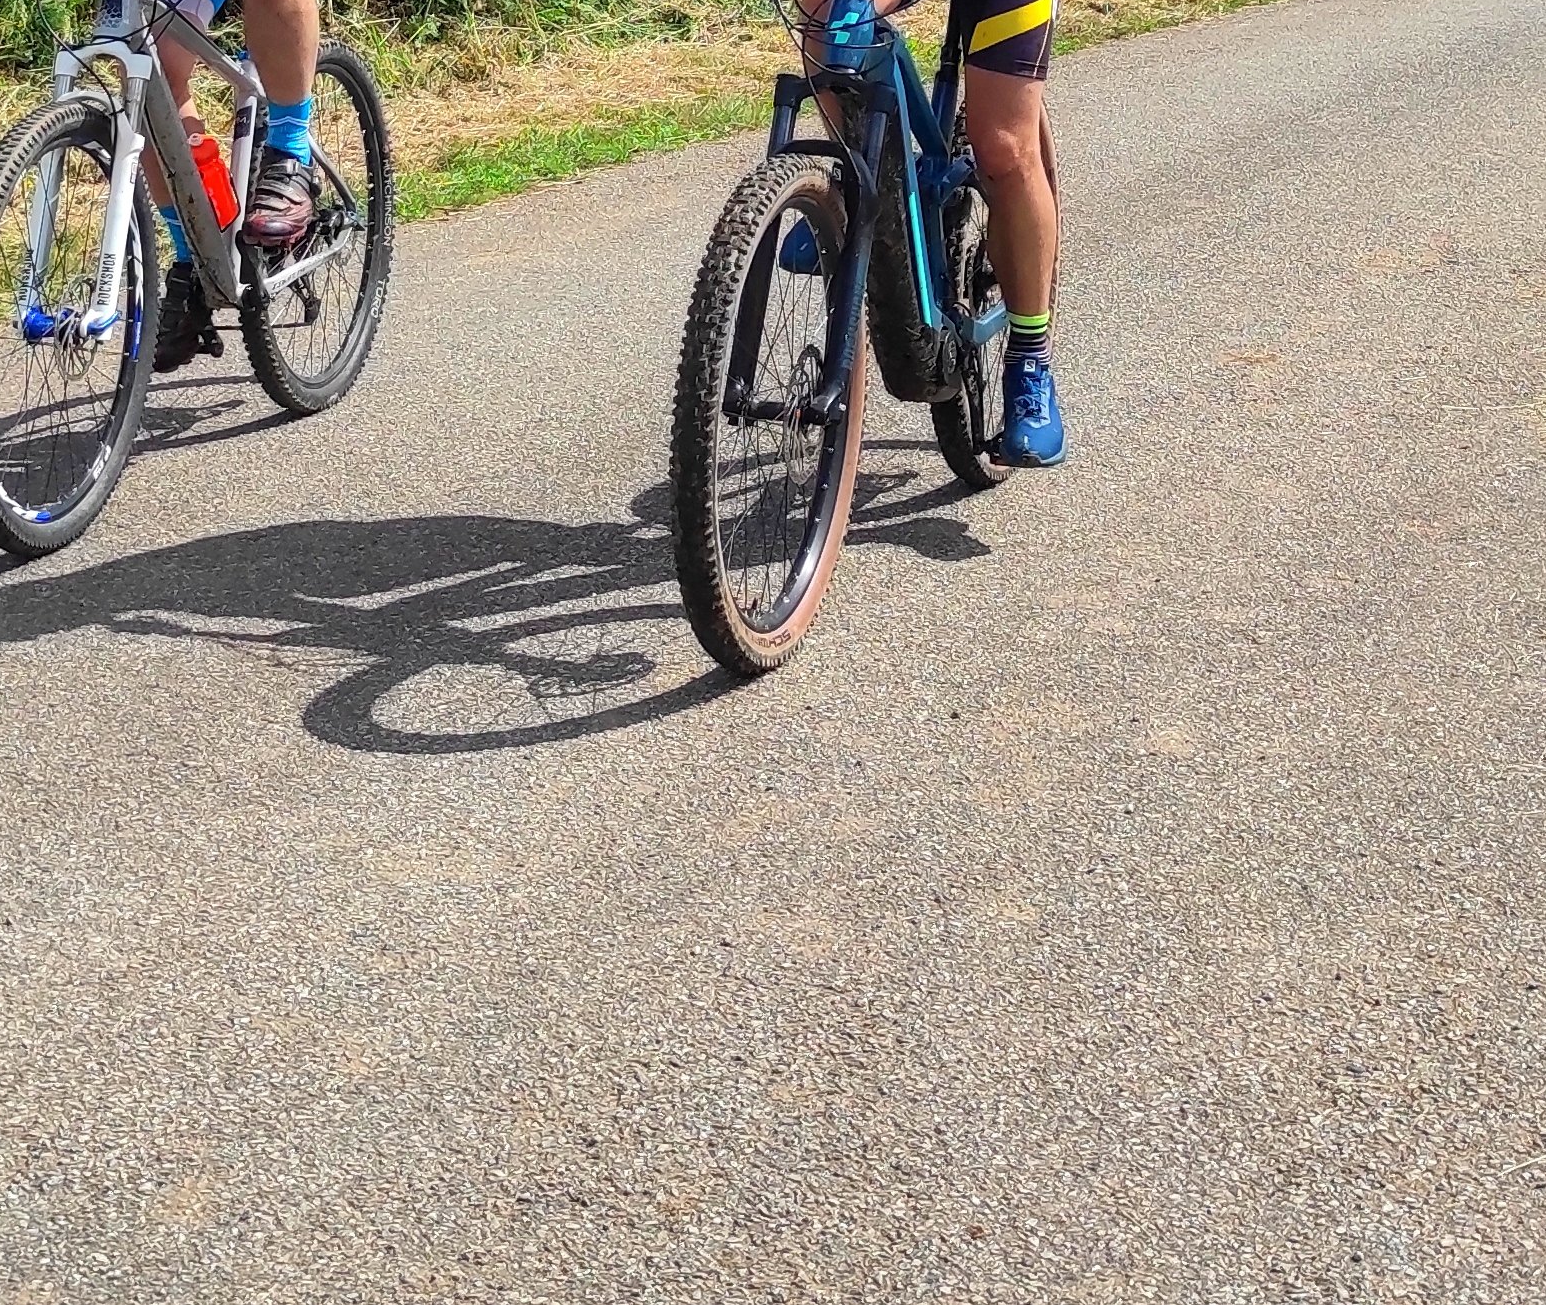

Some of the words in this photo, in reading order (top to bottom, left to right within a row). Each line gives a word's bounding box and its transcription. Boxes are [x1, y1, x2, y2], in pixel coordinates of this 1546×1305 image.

[382, 159, 393, 246] HUTCHINSON
[96, 253, 116, 306] ROCKSHOX
[370, 278, 386, 319] TORO
